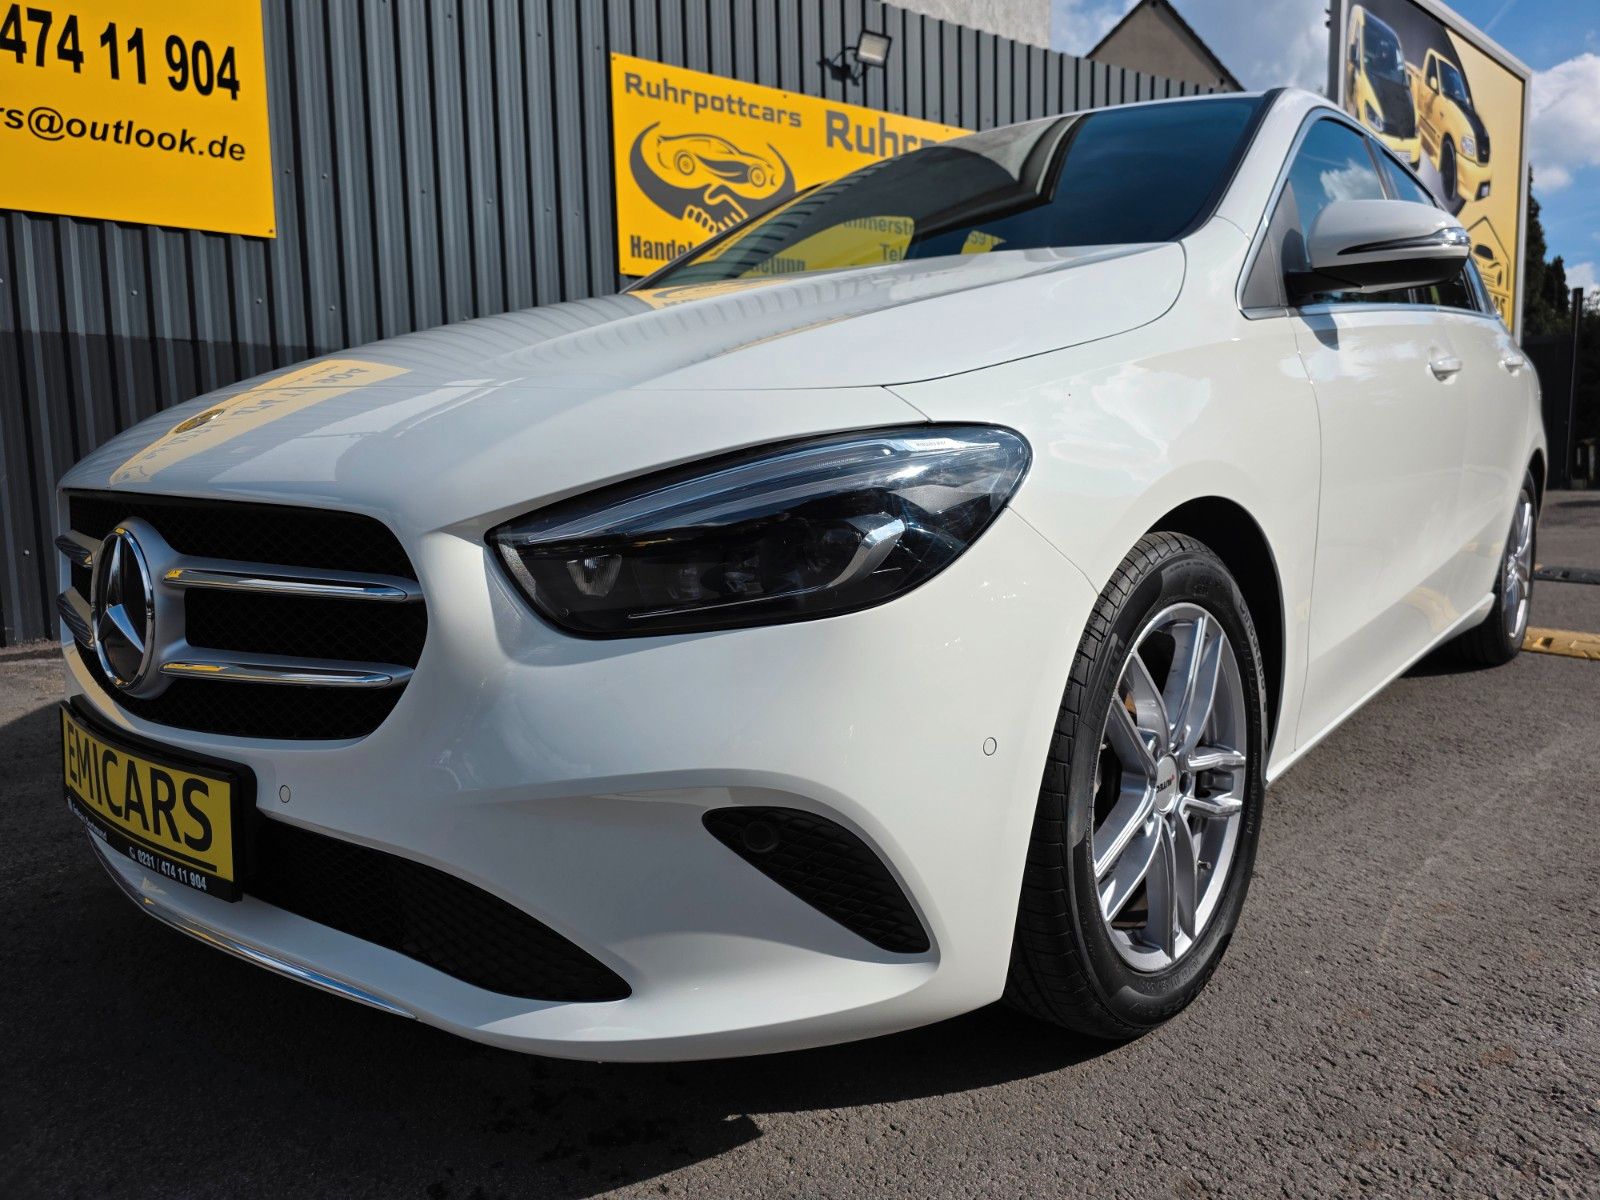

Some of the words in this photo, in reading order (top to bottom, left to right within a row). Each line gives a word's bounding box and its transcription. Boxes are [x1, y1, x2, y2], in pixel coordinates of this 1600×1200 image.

[0, 3, 84, 74] 474
[100, 22, 147, 85] 11
[165, 35, 240, 101] 904
[624, 72, 802, 128] Ruhrpottcars
[67, 721, 213, 852] EMICARS
[138, 849, 155, 869] 0231
[161, 861, 176, 879] 474
[178, 867, 188, 884] 11
[190, 872, 207, 891] 904
